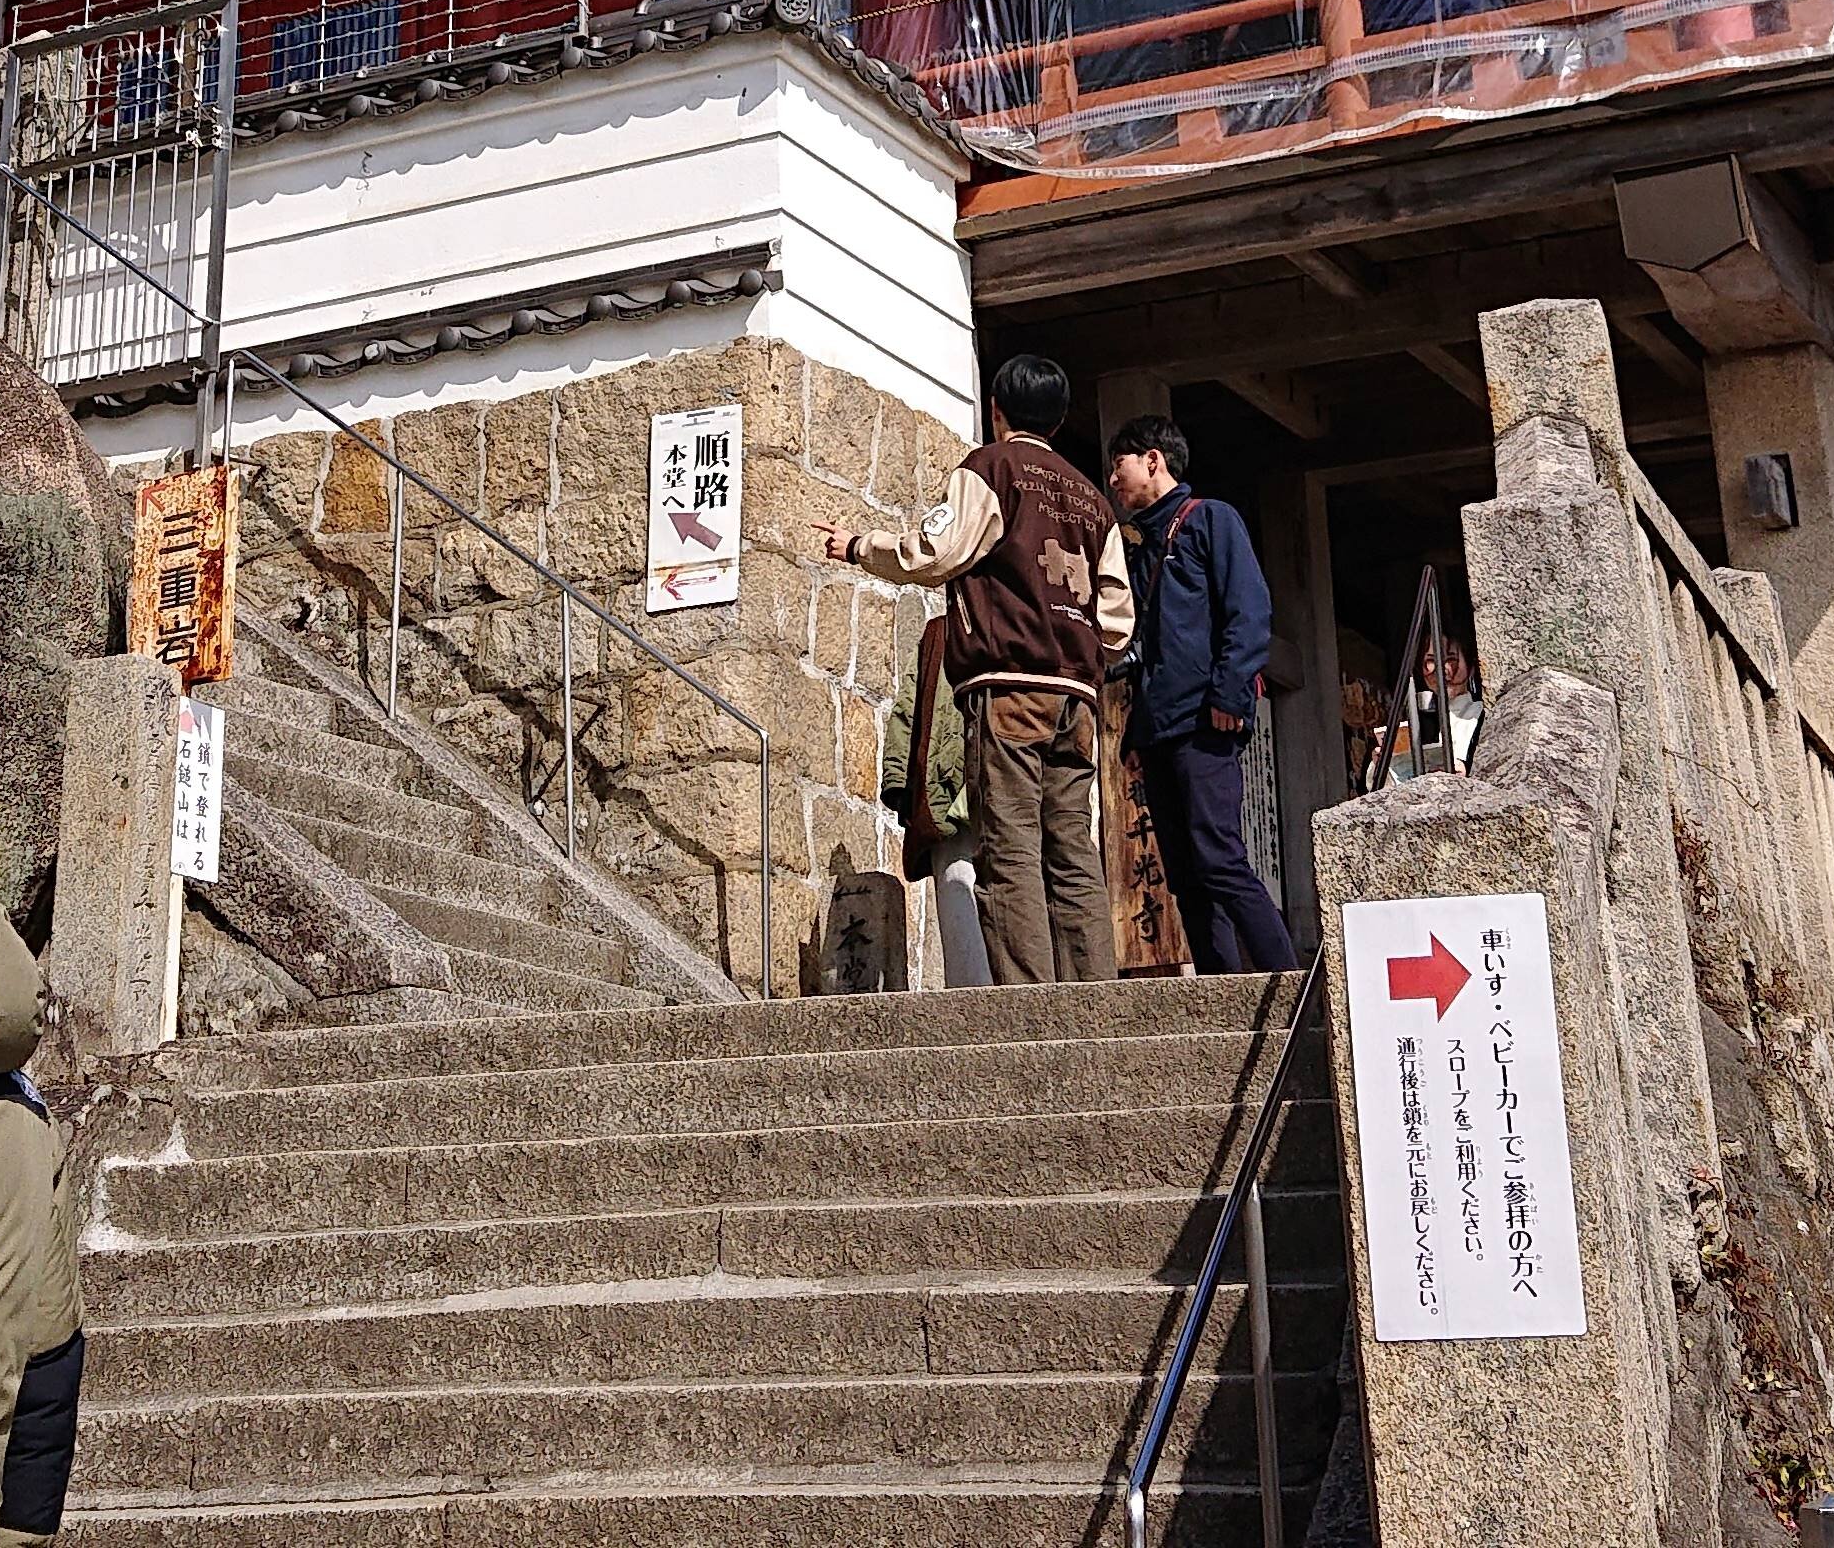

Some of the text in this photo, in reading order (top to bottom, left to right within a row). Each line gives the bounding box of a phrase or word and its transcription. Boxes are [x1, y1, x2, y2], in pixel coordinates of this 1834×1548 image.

[661, 443, 688, 510] 本堂へ
[693, 430, 730, 511] 順路
[154, 509, 201, 666] 三重岩
[193, 742, 212, 871] 鎖で登れる
[1396, 1036, 1439, 1316] 通行後は鎖を元にお戻しください。
[1447, 1039, 1484, 1261] スロープをご利用ください。
[1479, 928, 1538, 1298] 車いす・ベビーカーでご参拝の方へ
